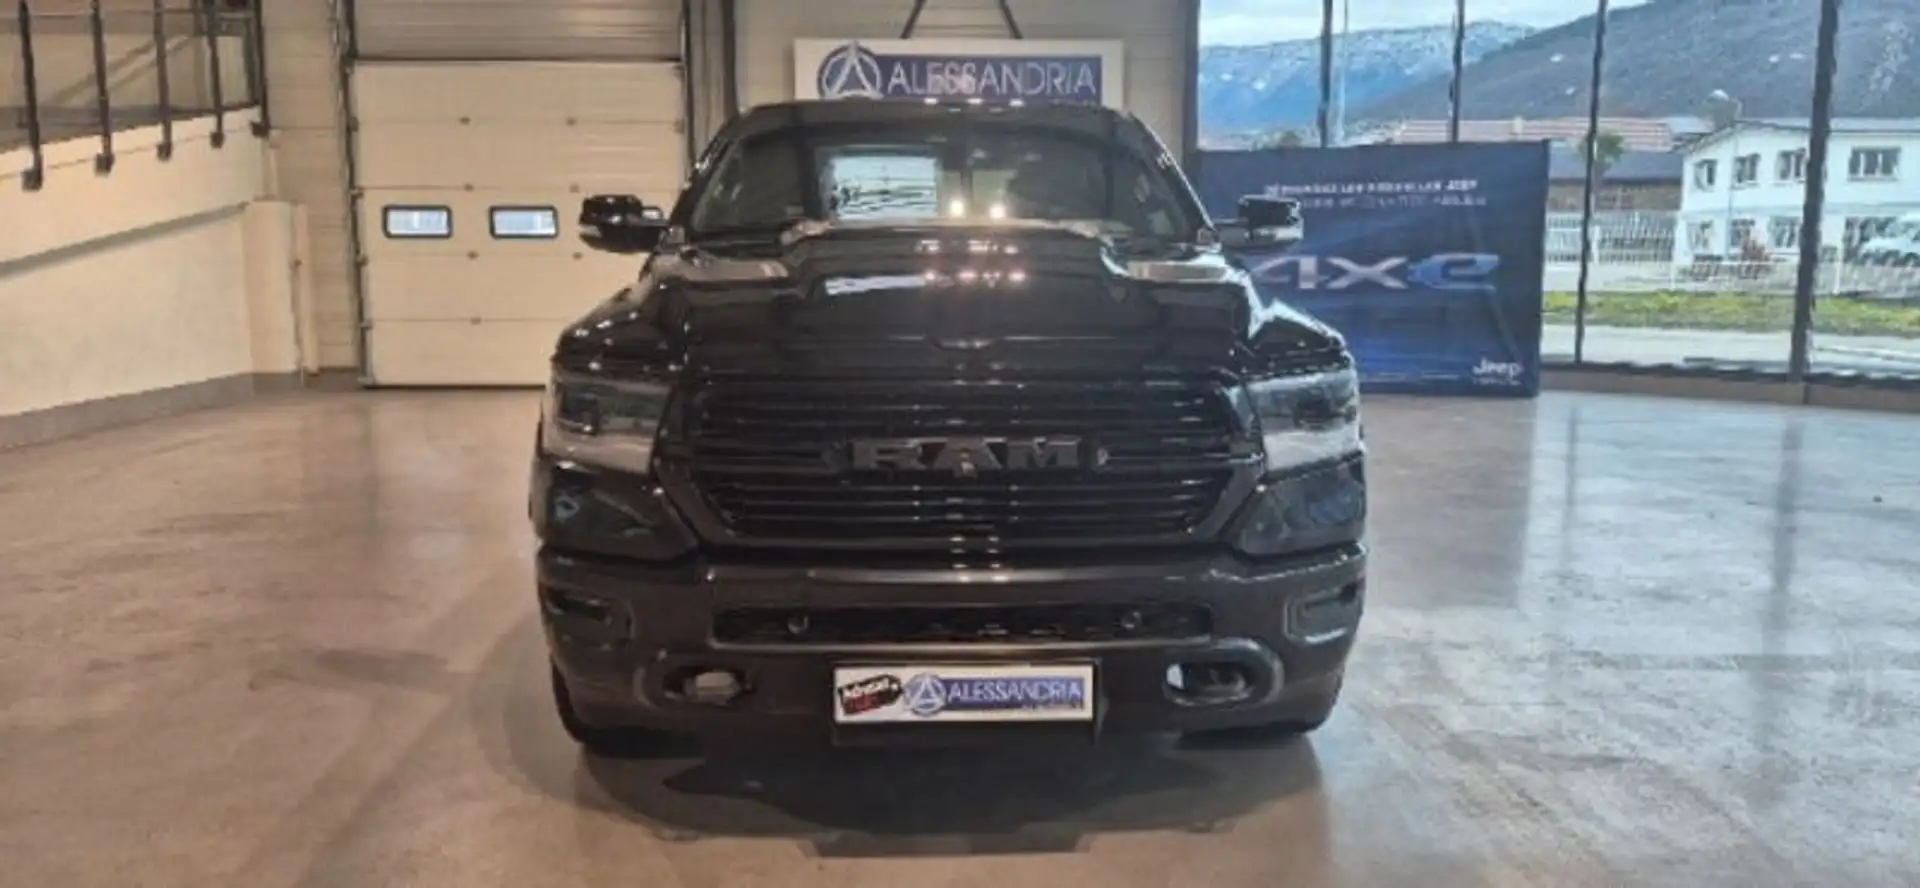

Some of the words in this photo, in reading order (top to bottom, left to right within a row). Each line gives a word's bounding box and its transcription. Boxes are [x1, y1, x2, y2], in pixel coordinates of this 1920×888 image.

[887, 61, 1096, 96] ALESSANDRIA
[1472, 356, 1523, 378] Jeep
[853, 437, 1081, 470] RAM
[949, 681, 1082, 700] ALESSANDRIA
